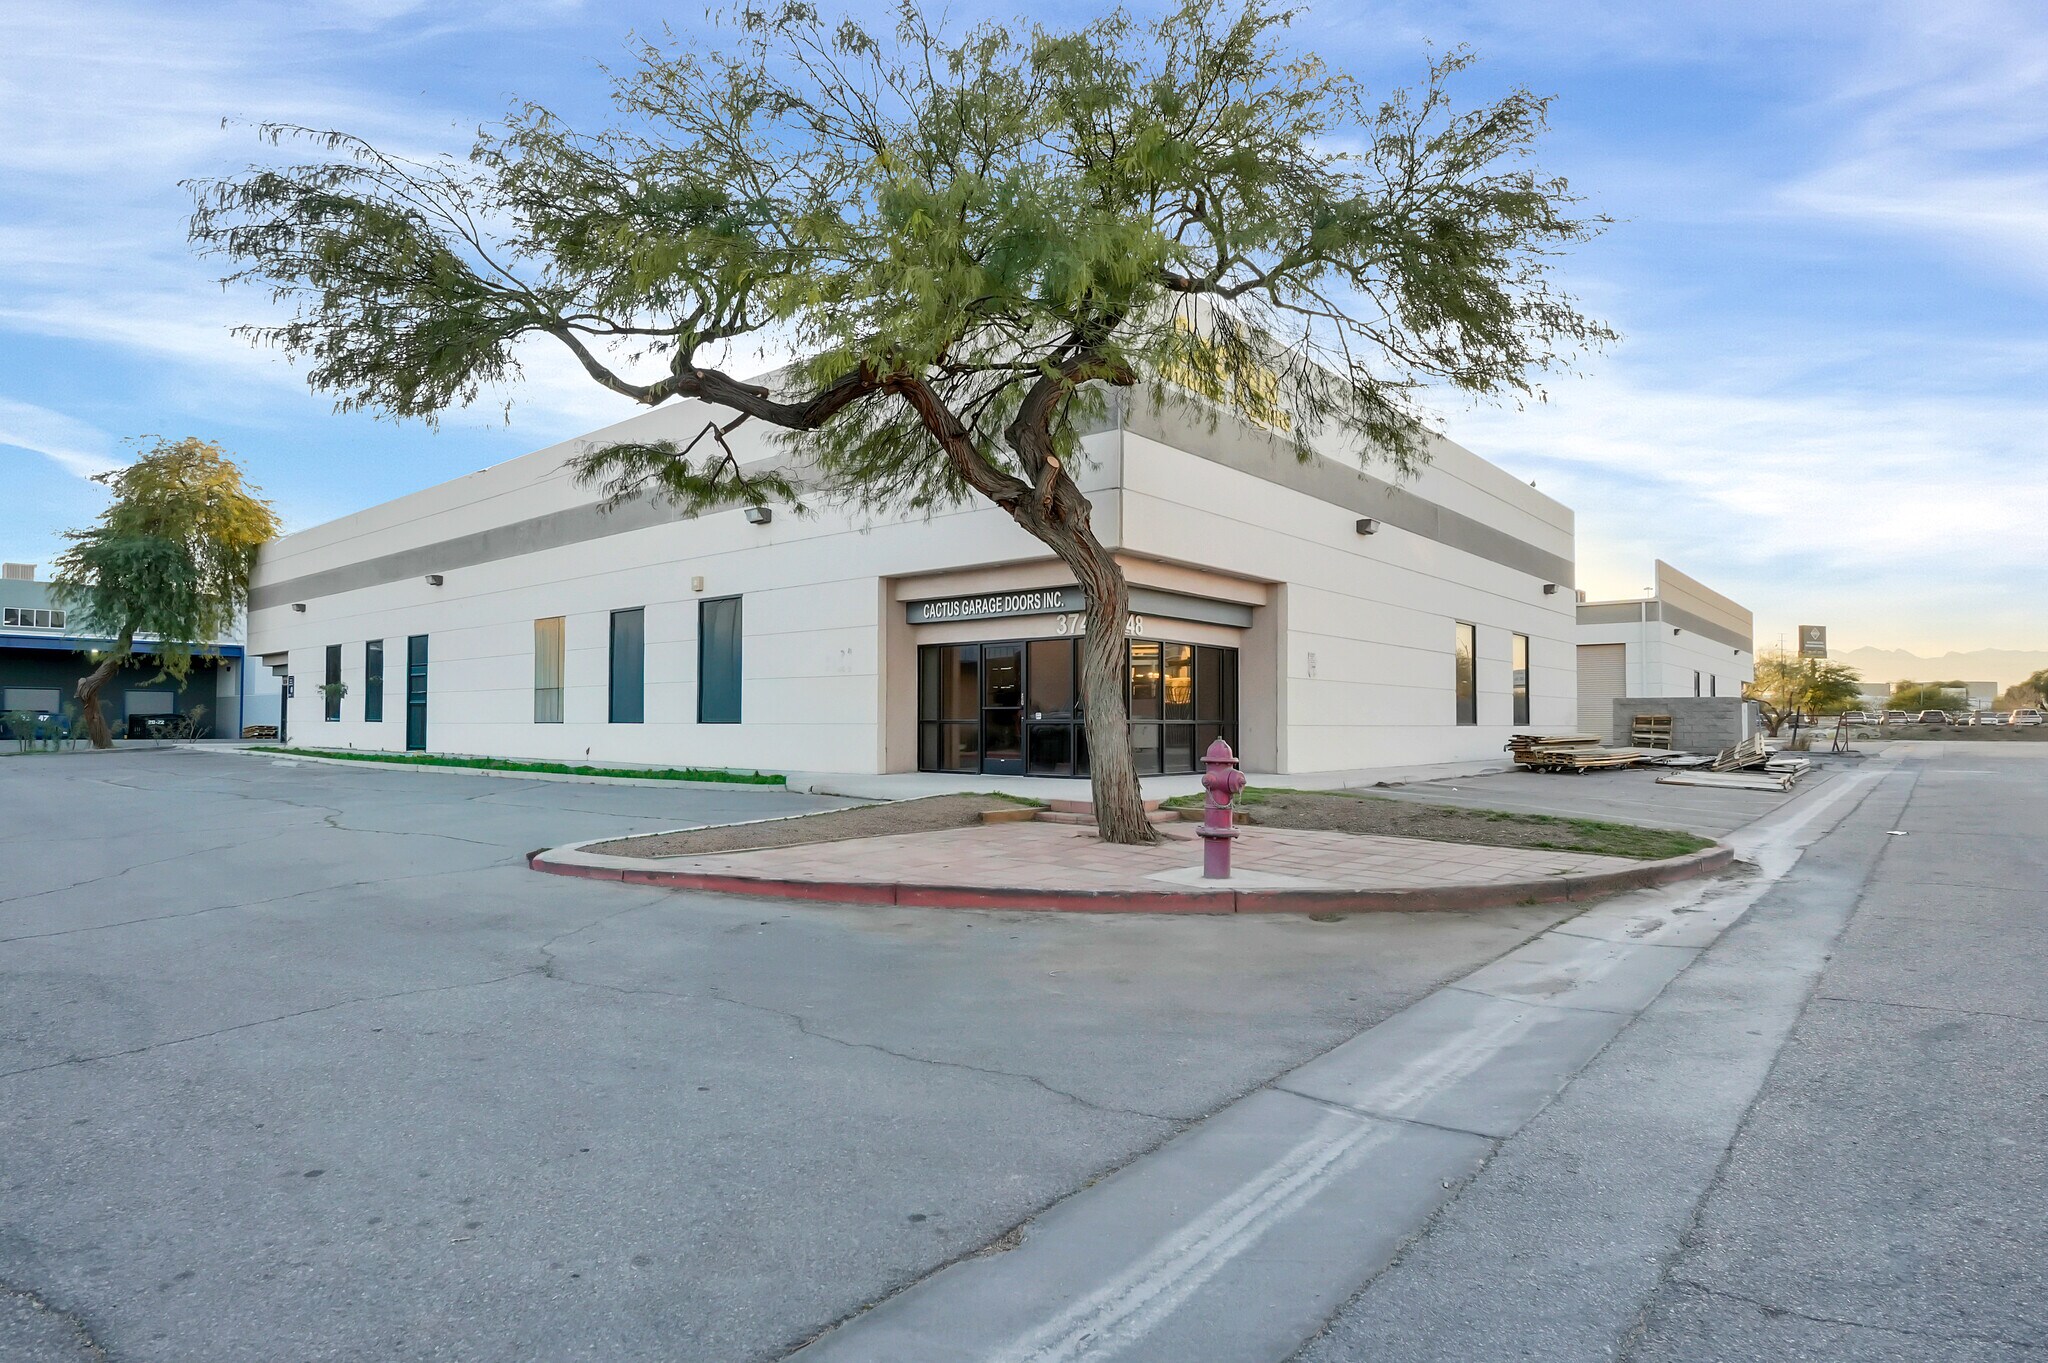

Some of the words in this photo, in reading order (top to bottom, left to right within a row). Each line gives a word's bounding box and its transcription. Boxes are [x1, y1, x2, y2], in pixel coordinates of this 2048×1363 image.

[923, 601, 960, 618] CACTUS
[961, 597, 1003, 615] GARAGE
[1005, 593, 1041, 612] DOORS
[1043, 591, 1064, 608] INC.
